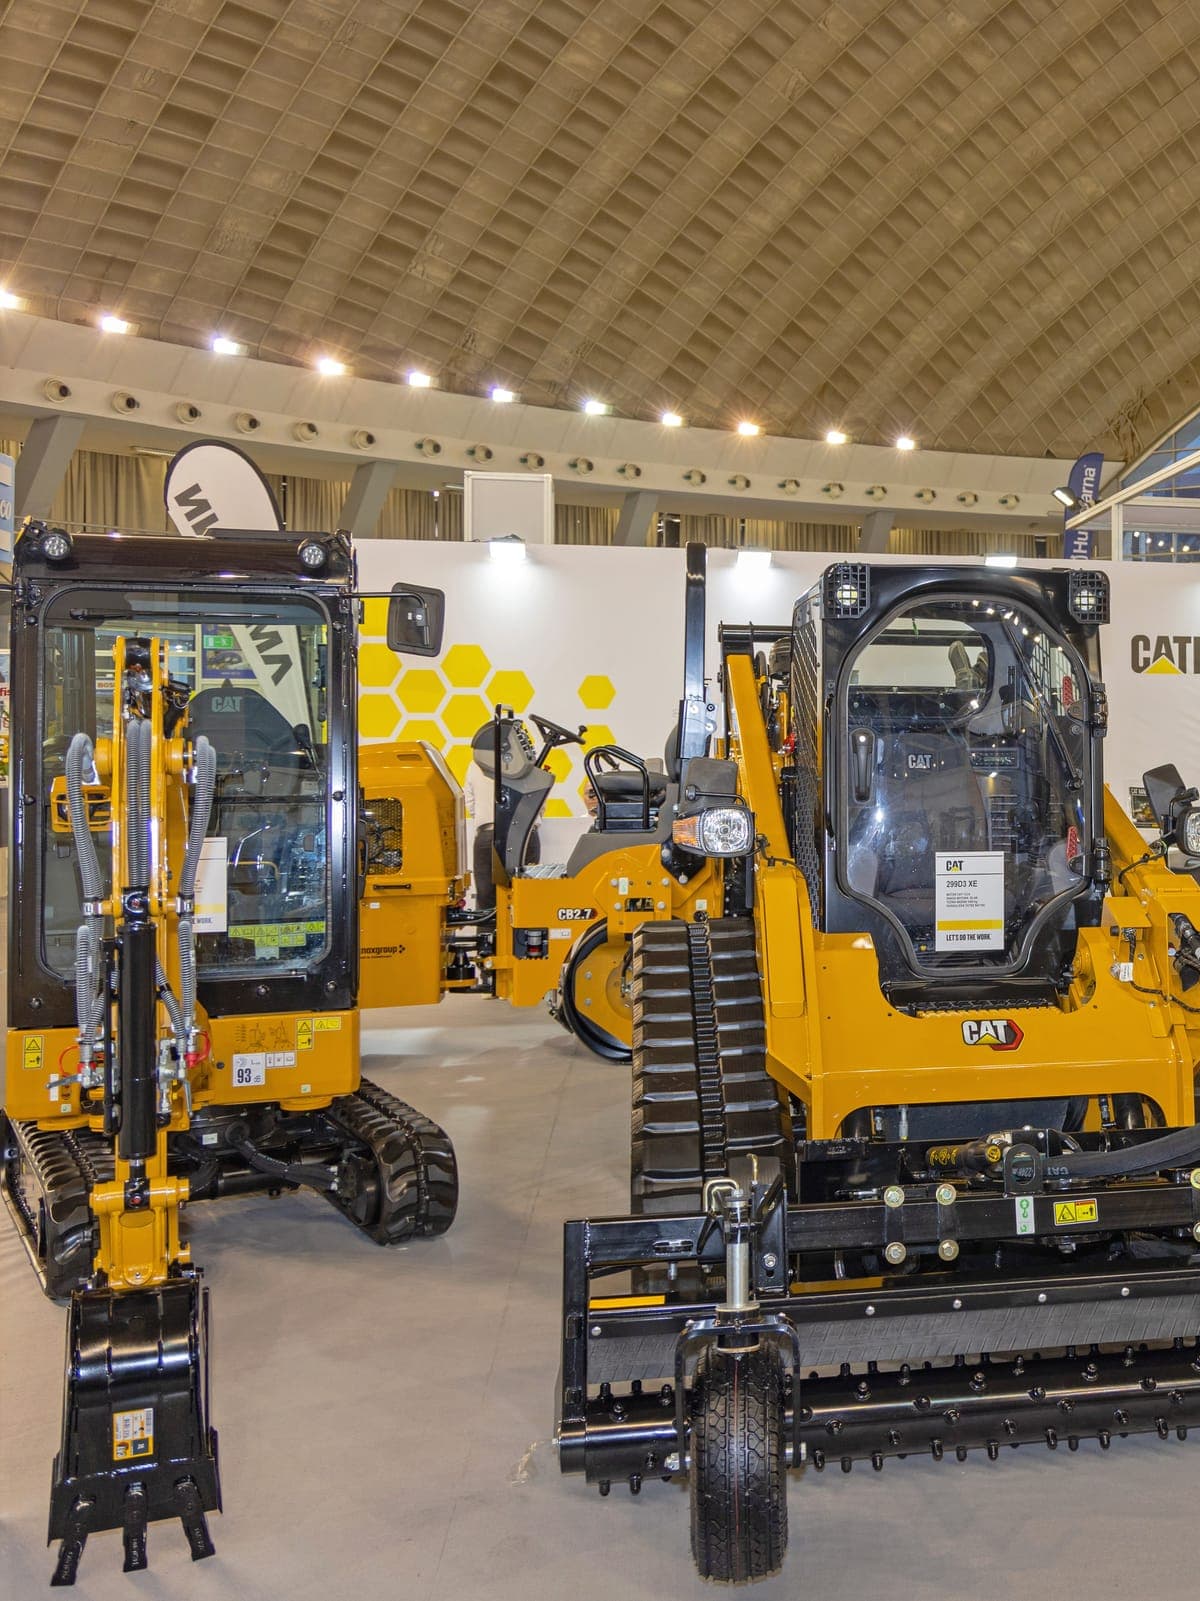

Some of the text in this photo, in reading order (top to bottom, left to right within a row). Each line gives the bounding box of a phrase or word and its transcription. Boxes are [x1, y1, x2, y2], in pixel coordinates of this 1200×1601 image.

[211, 696, 243, 713] CAT
[907, 754, 932, 769] CAT
[946, 860, 964, 872] CAT
[968, 880, 978, 888] XE
[558, 907, 593, 921] CB2.7
[967, 933, 977, 941] THE
[963, 1020, 1008, 1045] CAT
[237, 1068, 252, 1084] 93
